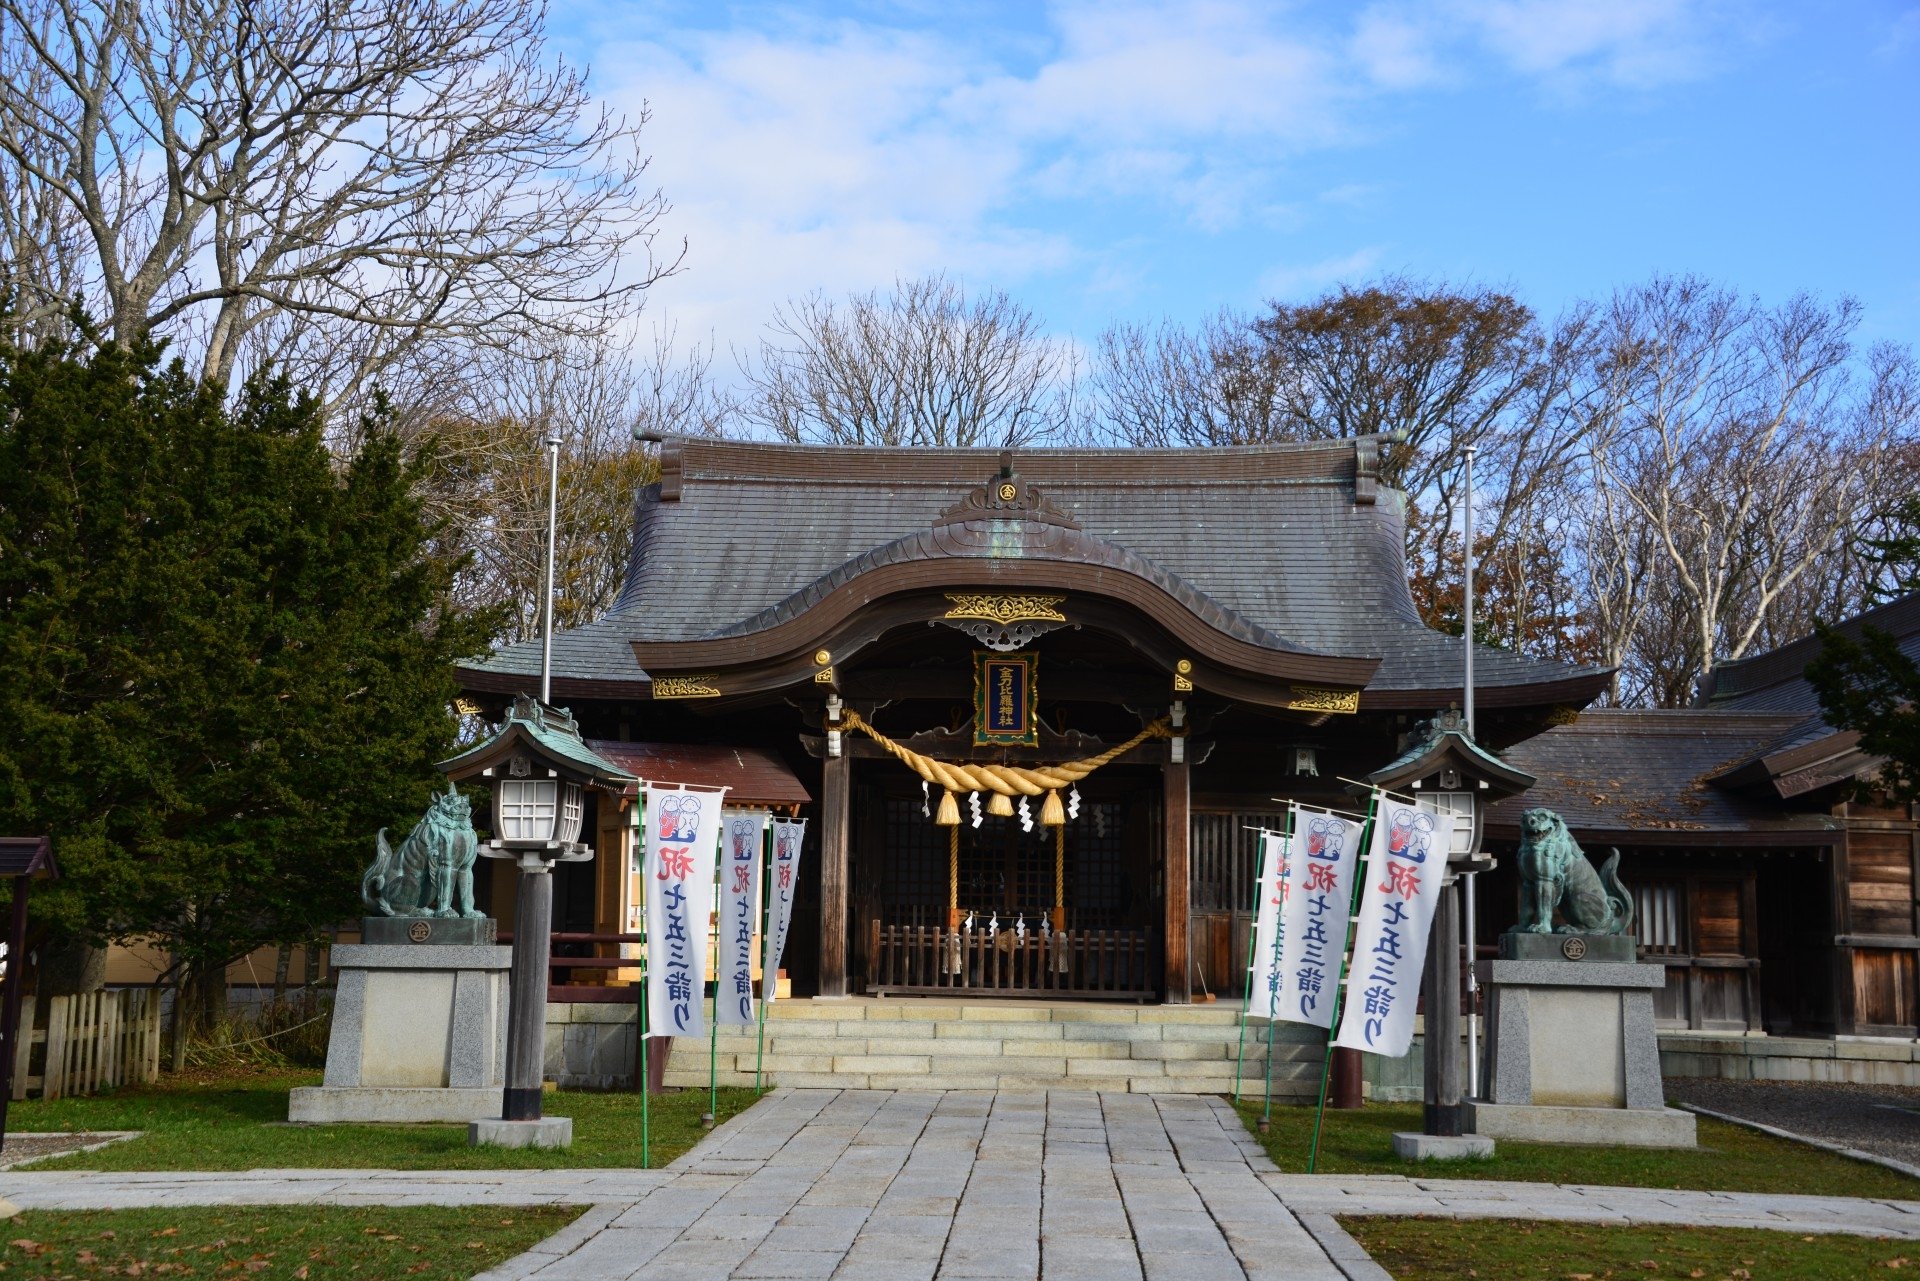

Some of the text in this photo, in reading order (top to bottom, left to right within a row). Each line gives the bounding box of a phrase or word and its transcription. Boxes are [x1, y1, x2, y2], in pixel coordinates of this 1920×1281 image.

[1001, 486, 1014, 498] 金
[998, 666, 1014, 727] 金刀比羅神社
